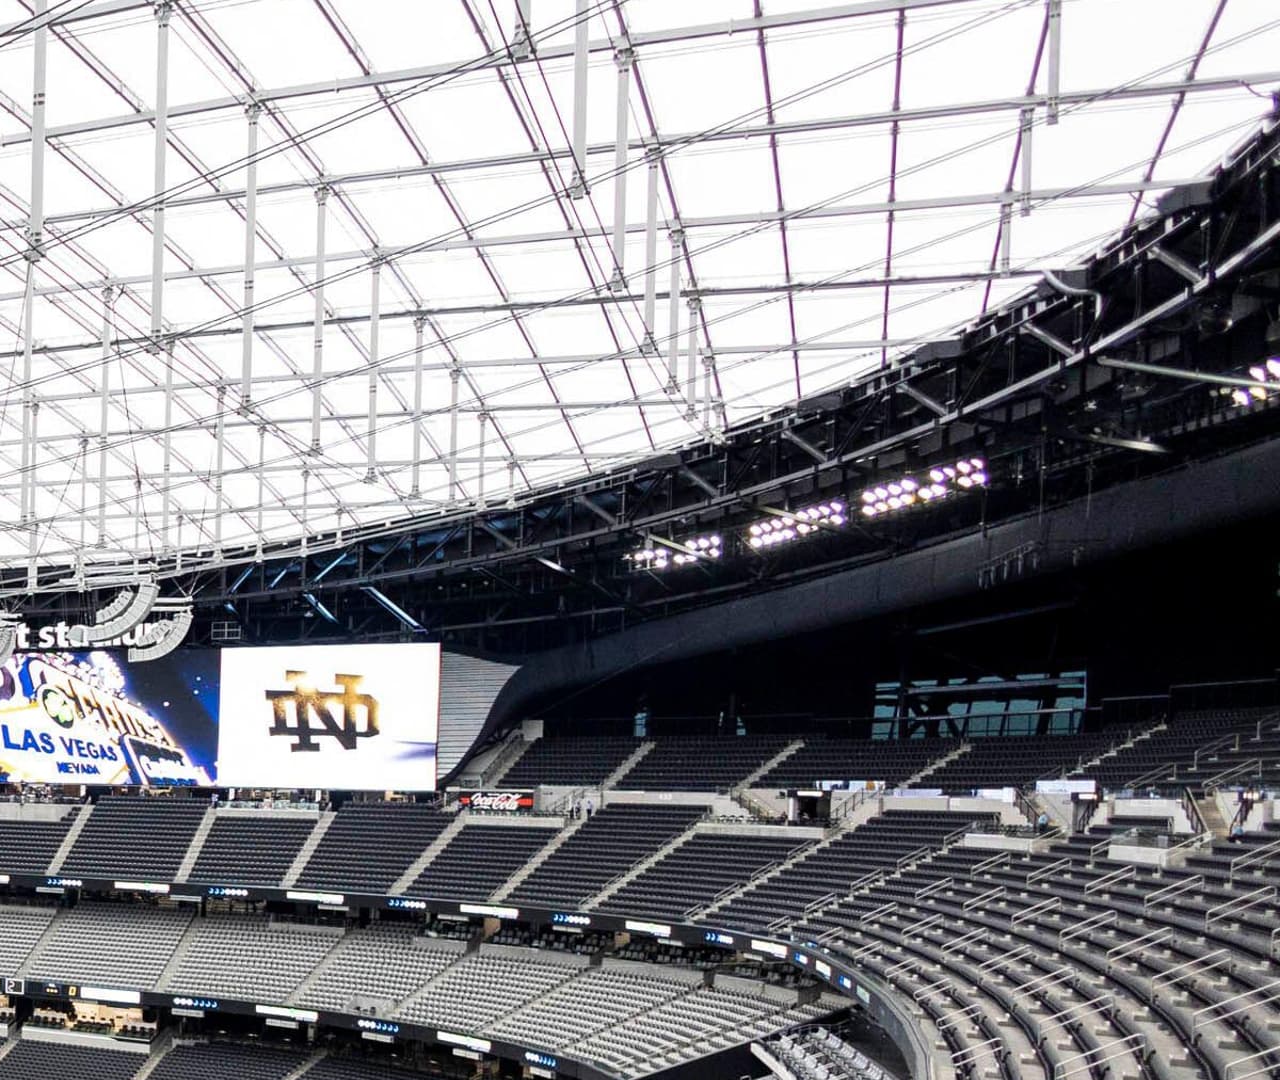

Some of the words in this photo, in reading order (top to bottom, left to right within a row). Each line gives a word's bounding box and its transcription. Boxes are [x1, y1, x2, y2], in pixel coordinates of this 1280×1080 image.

[1, 724, 56, 756] LAS
[59, 735, 119, 762] VEGAS
[56, 760, 101, 776] NEVADA
[470, 792, 523, 811] Coca-Cola
